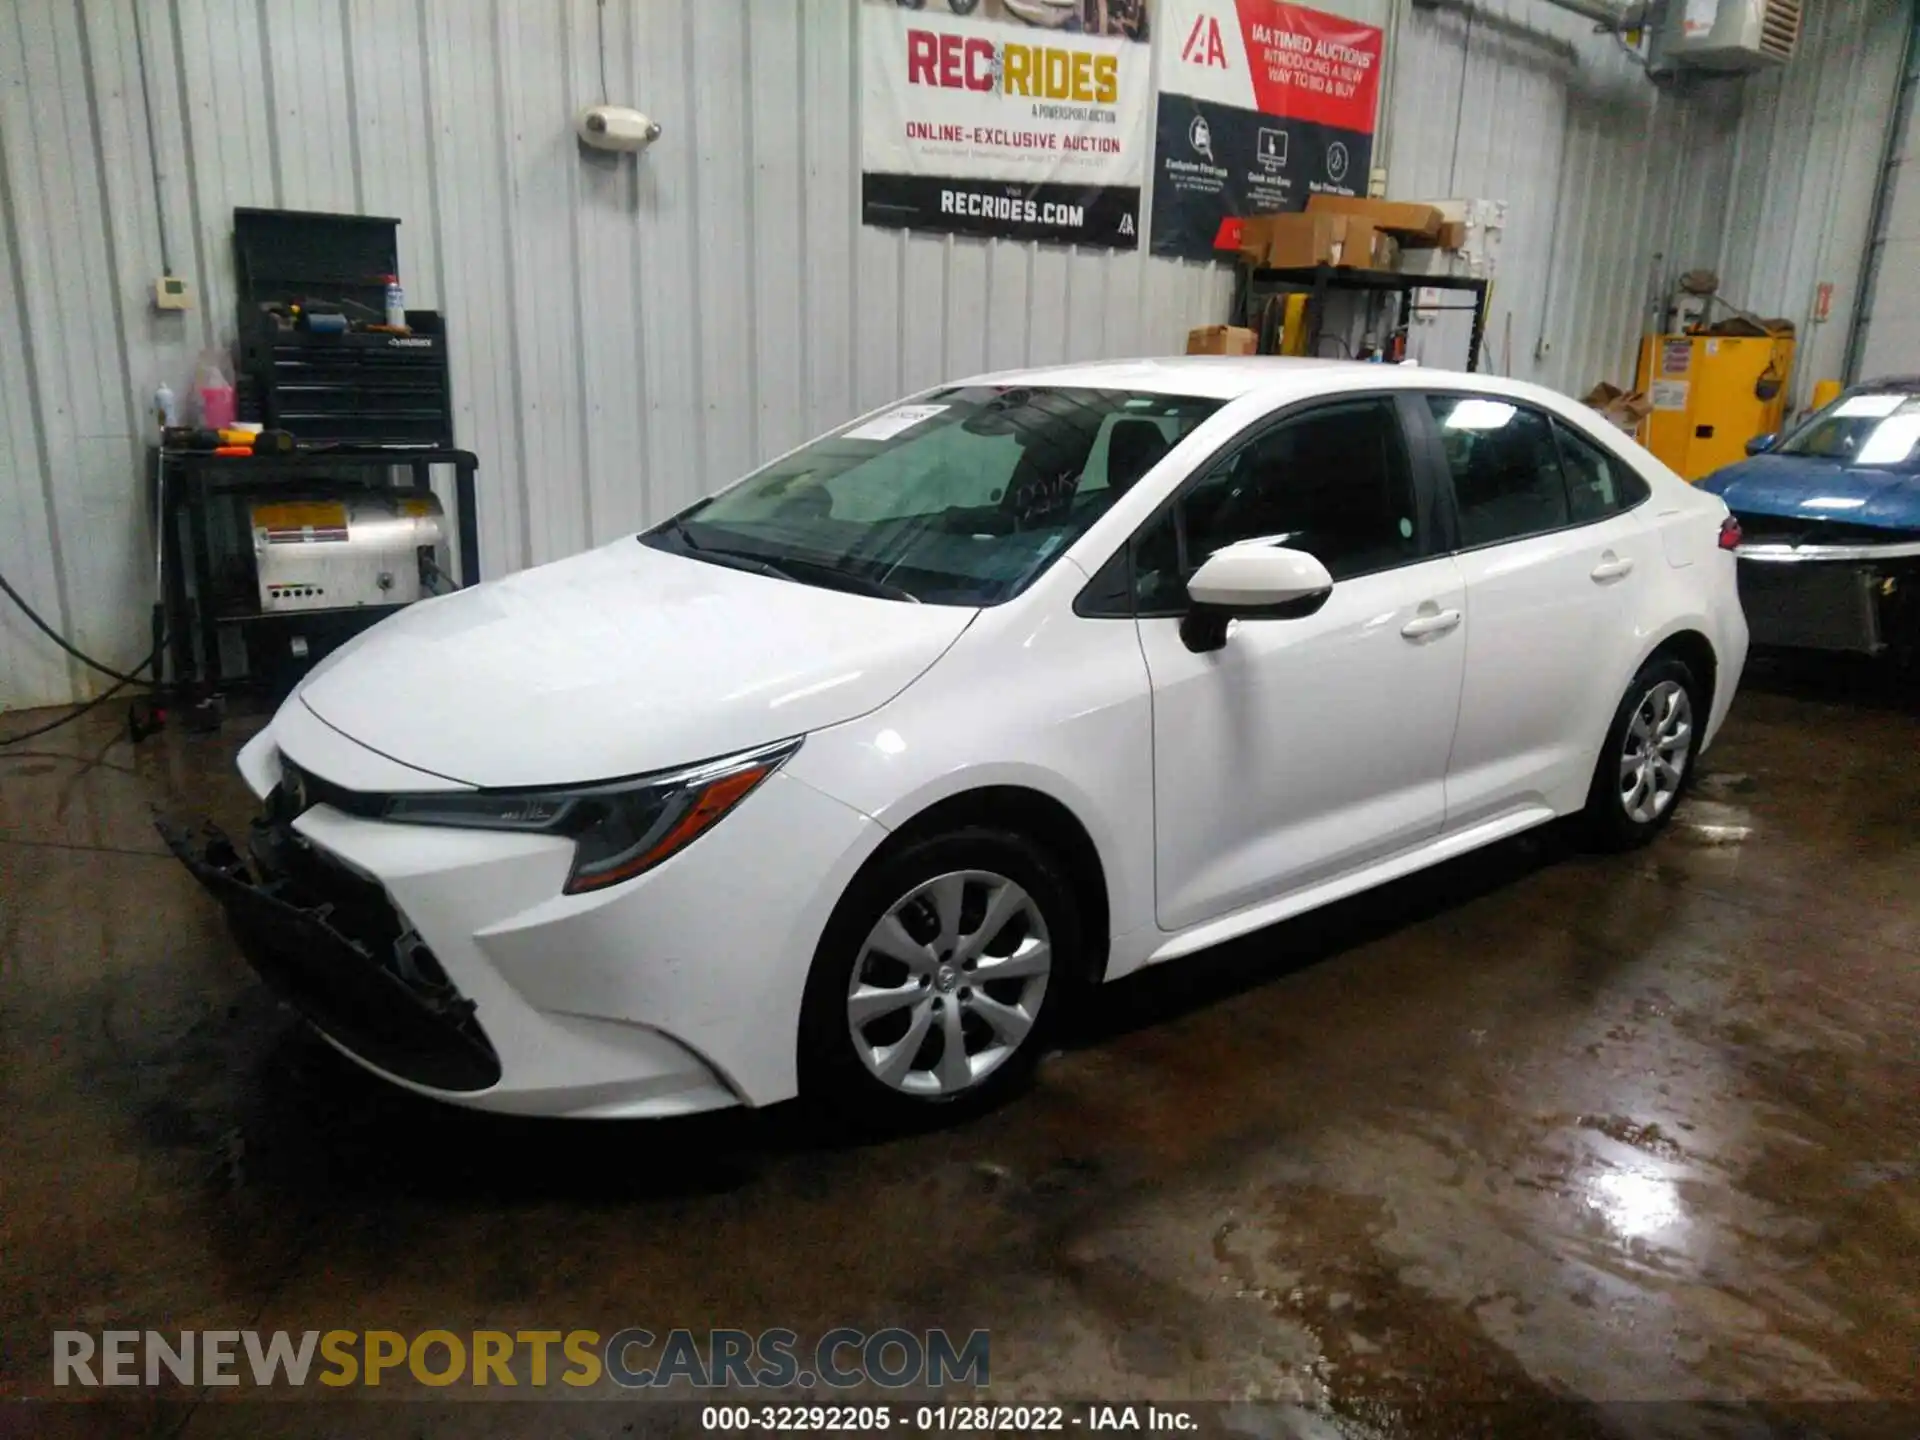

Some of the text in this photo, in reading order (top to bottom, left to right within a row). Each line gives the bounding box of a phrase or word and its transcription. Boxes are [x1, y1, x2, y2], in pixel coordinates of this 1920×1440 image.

[1252, 23, 1272, 44] IAA
[1273, 29, 1312, 53] TIMED
[907, 28, 1118, 104] REC RIDES
[1268, 65, 1292, 85] WAY
[1294, 70, 1308, 88] TO
[1335, 81, 1356, 98] BUY
[906, 121, 1121, 153] ONLINE-EXCLUSIVE AUCTION
[941, 189, 1084, 228] RECRIDES.COM
